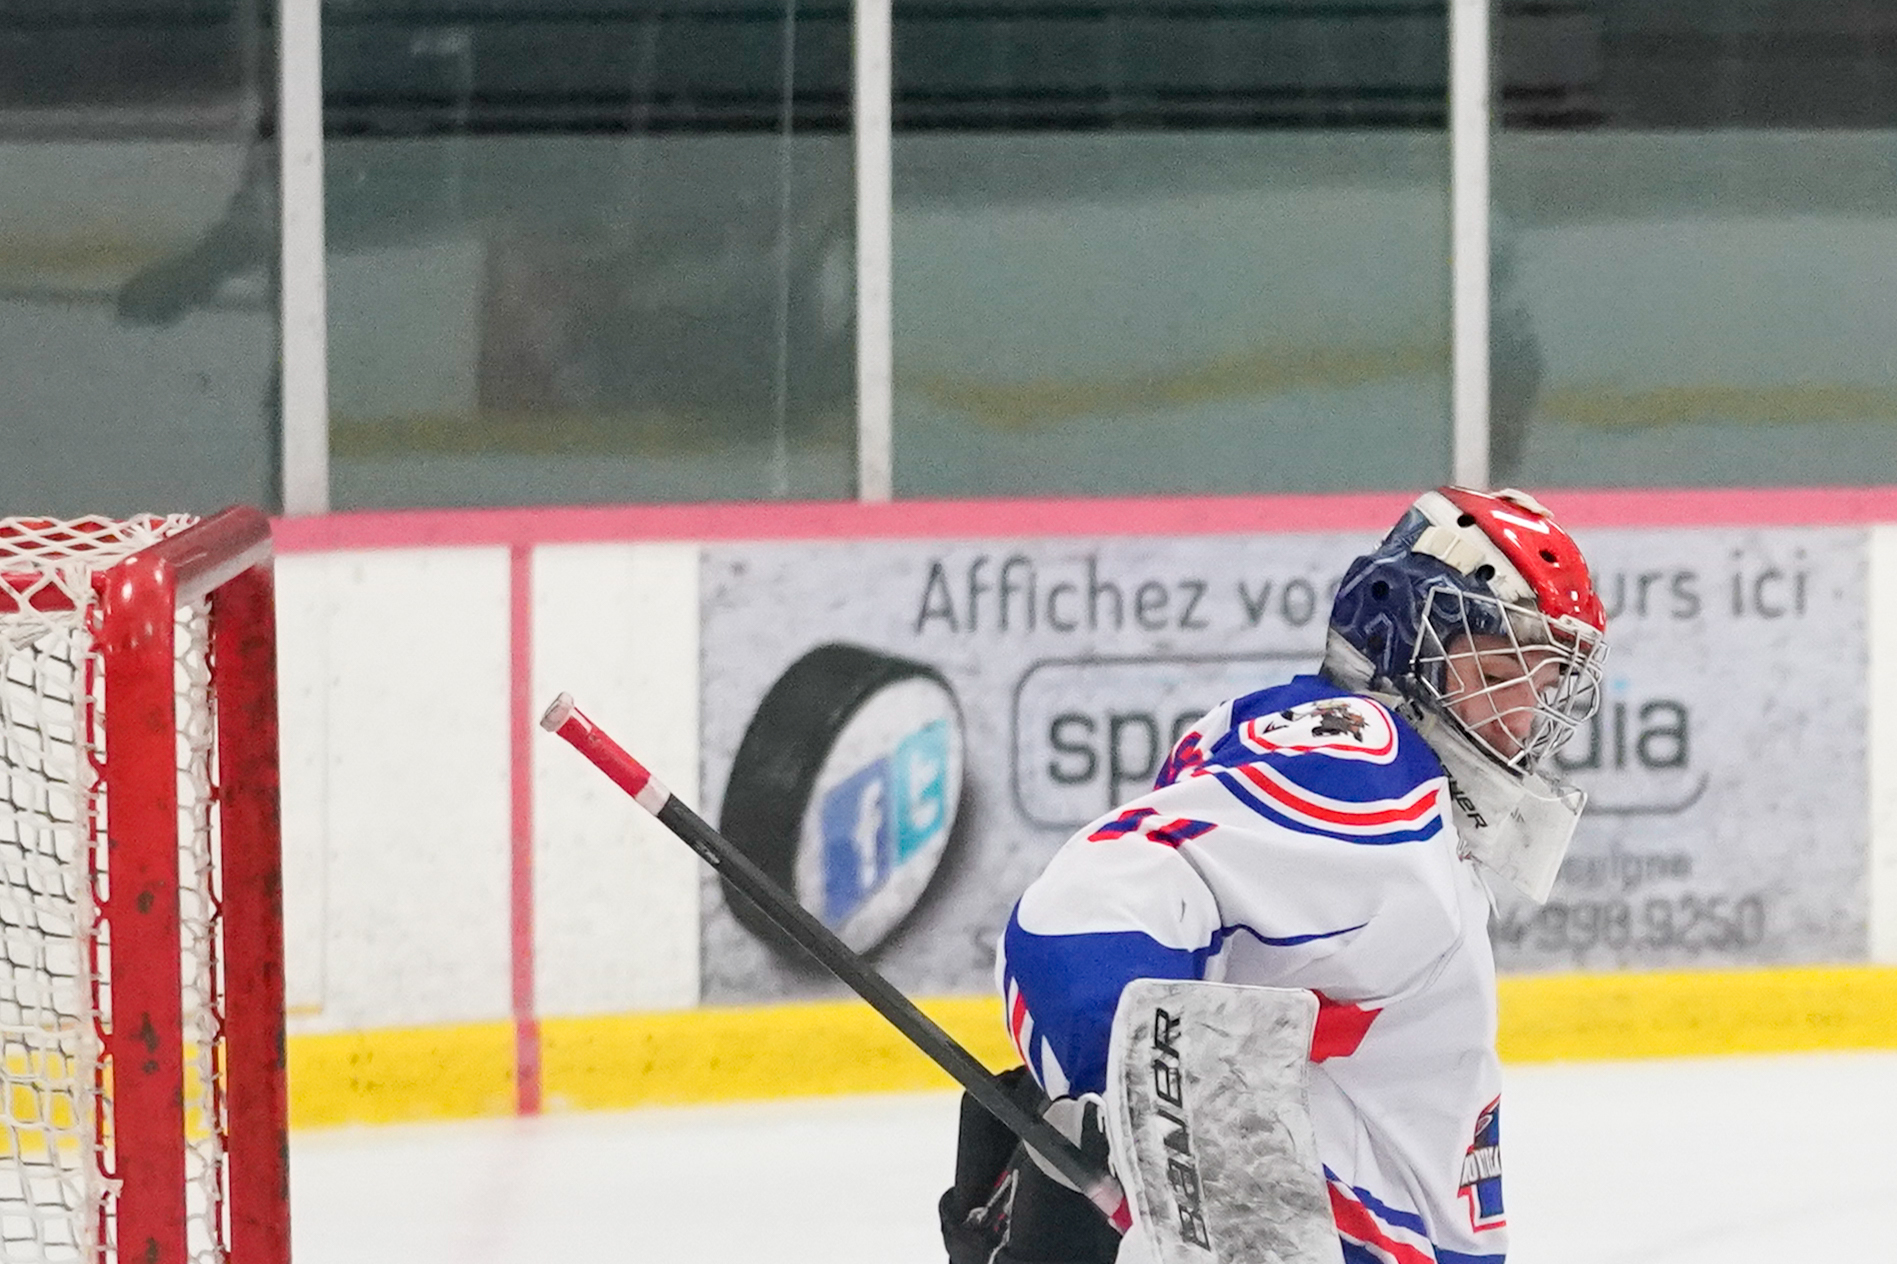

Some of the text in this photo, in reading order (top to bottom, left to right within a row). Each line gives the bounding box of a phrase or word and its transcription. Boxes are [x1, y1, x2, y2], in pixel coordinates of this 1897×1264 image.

[913, 553, 1210, 636] Affichez
[1730, 548, 1809, 620] ici
[1152, 1007, 1212, 1252] BAUER
